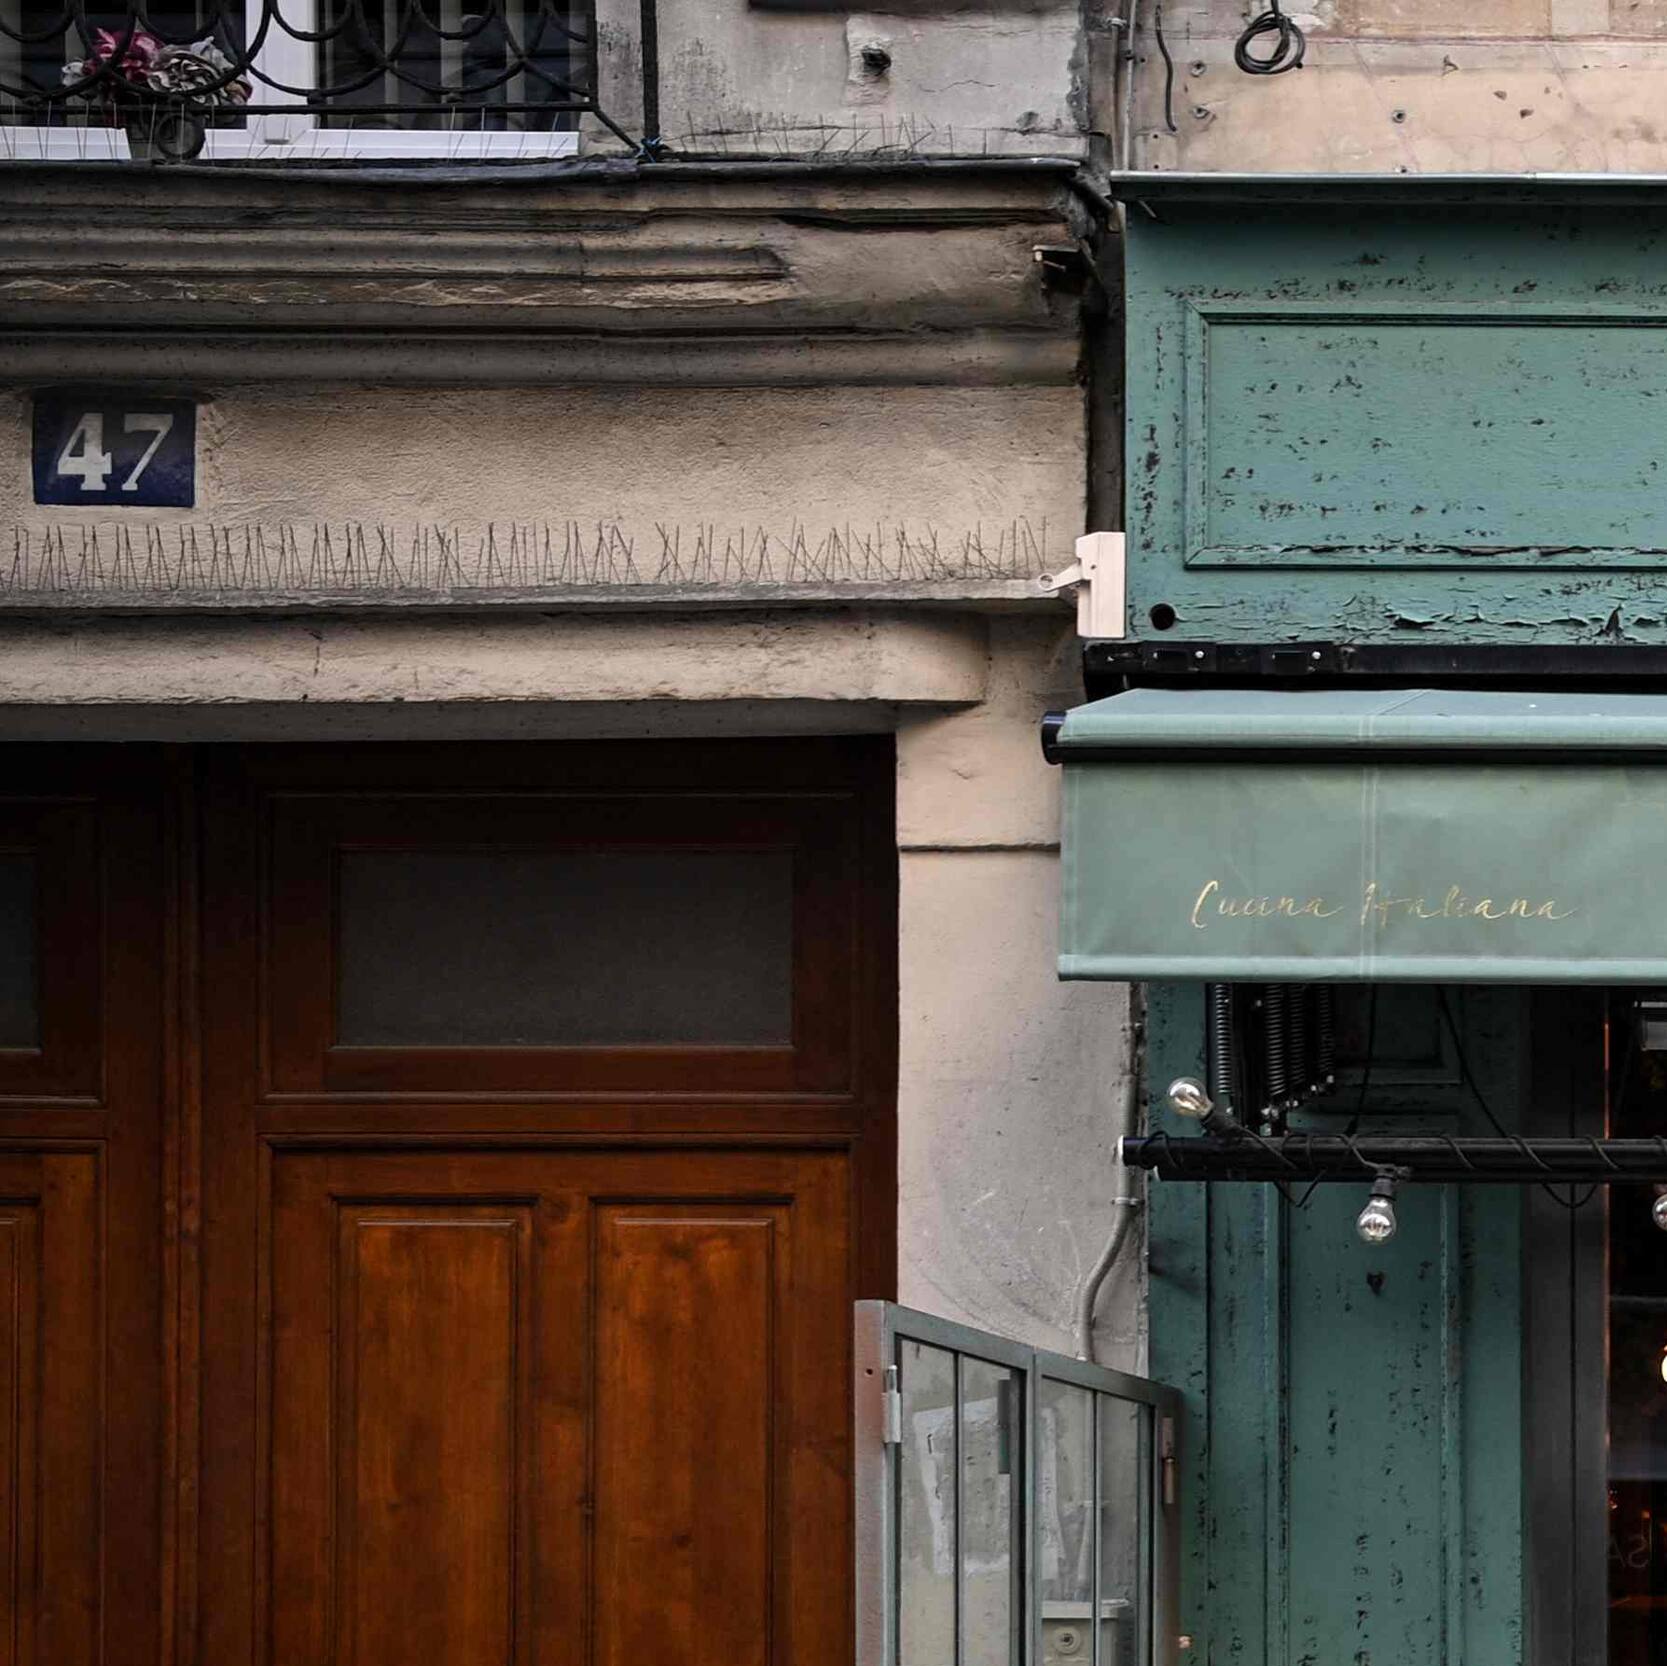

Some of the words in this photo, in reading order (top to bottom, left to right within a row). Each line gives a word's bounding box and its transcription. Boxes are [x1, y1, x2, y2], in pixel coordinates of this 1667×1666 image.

[56, 411, 174, 492] 47
[1189, 879, 1344, 930] Cucina
[1358, 880, 1578, 929] Italiana
